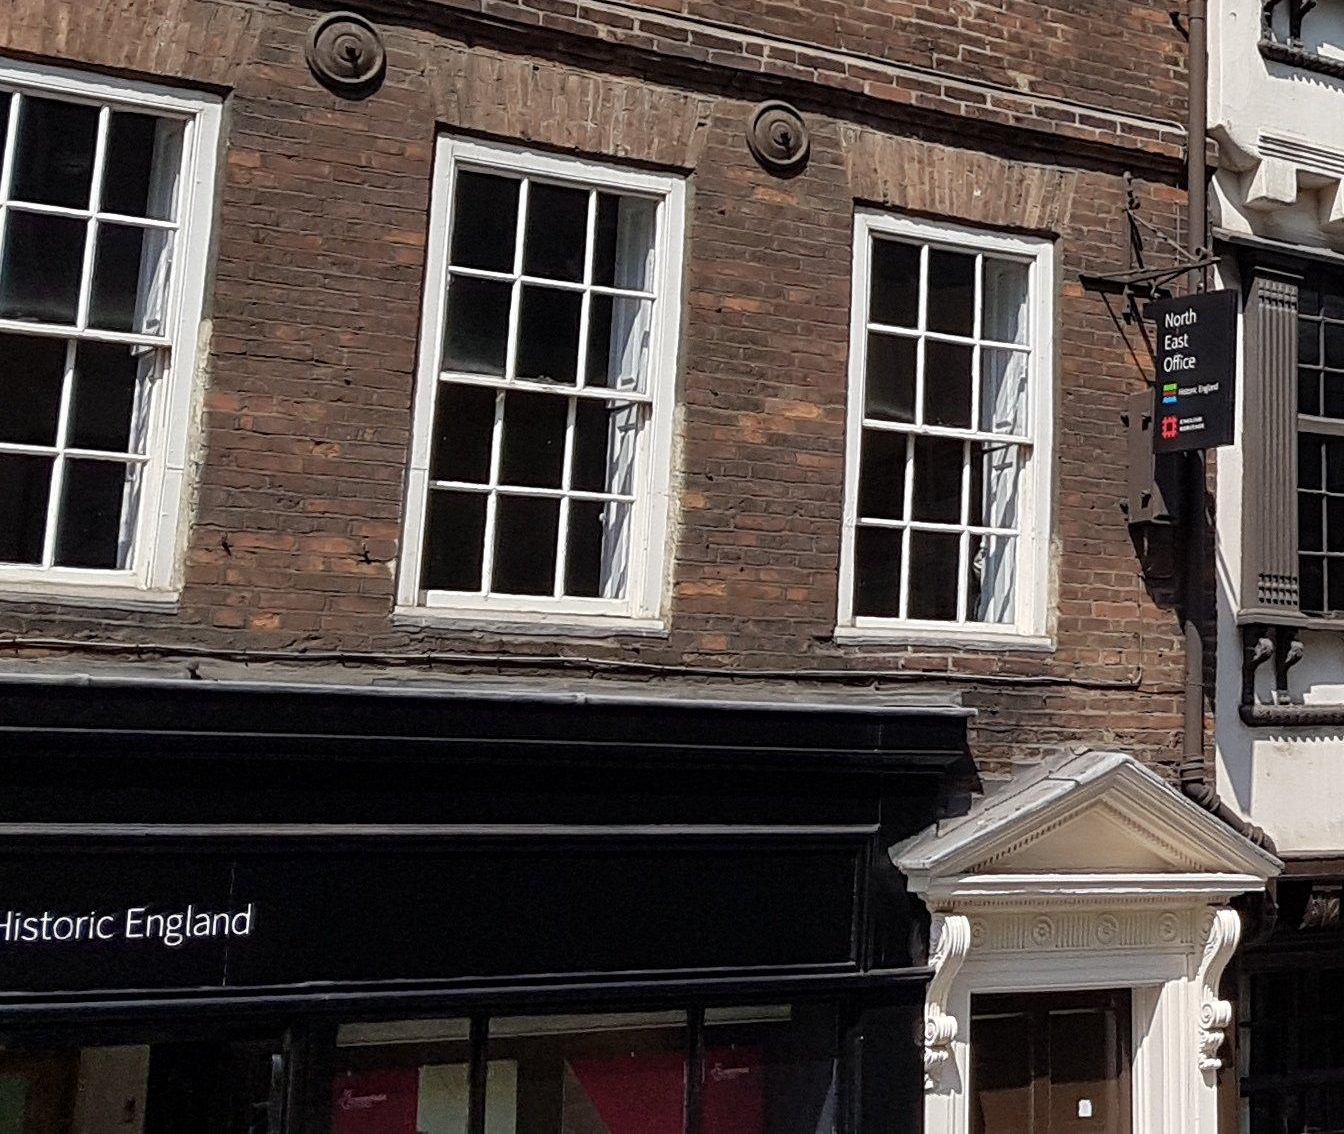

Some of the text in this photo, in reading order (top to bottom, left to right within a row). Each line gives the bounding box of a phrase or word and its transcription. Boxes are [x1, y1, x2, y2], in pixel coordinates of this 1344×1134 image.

[1165, 308, 1197, 328] North
[1164, 333, 1189, 351] East
[1163, 354, 1196, 373] Office
[125, 903, 253, 947] England
